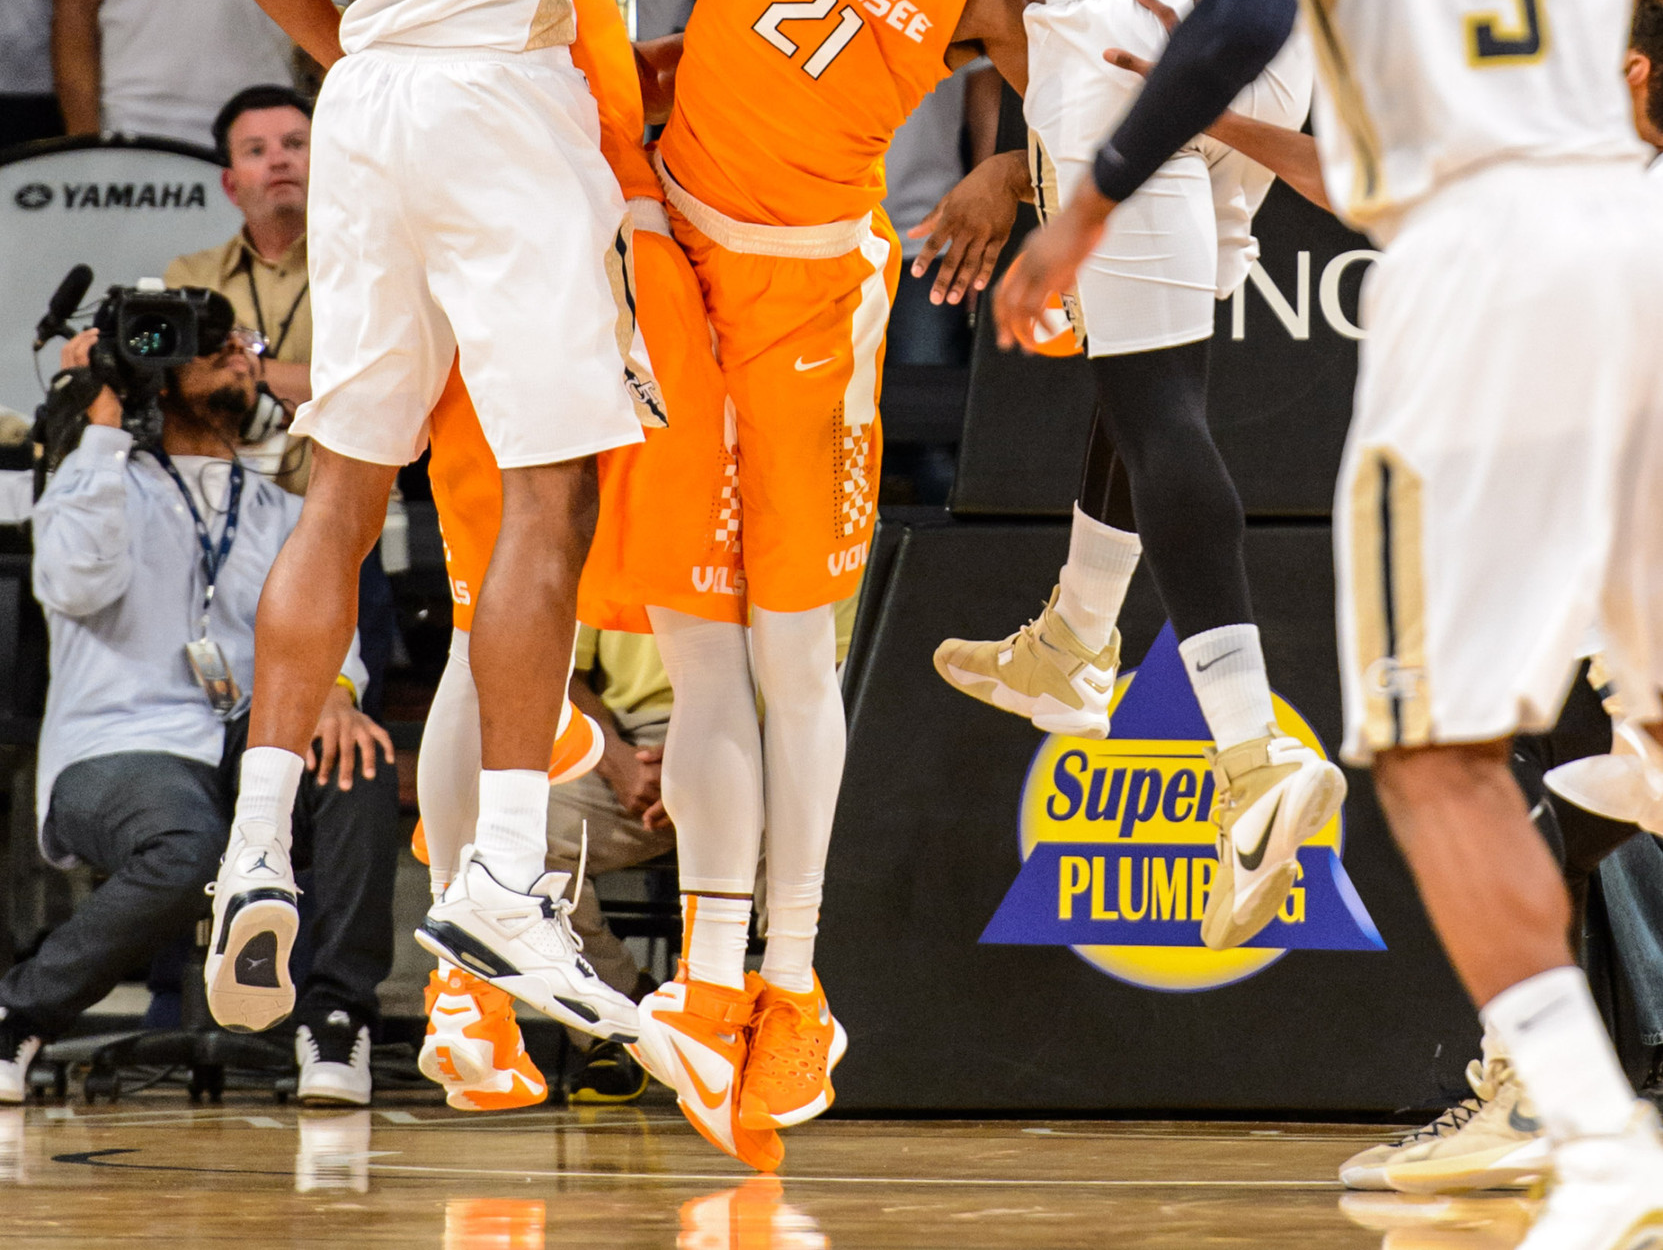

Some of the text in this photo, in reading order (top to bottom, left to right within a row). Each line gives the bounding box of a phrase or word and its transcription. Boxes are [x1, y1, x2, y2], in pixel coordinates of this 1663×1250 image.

[62, 182, 207, 209] YAMAHA
[1046, 749, 1218, 839] Super
[1057, 855, 1307, 924] PLUMBG
